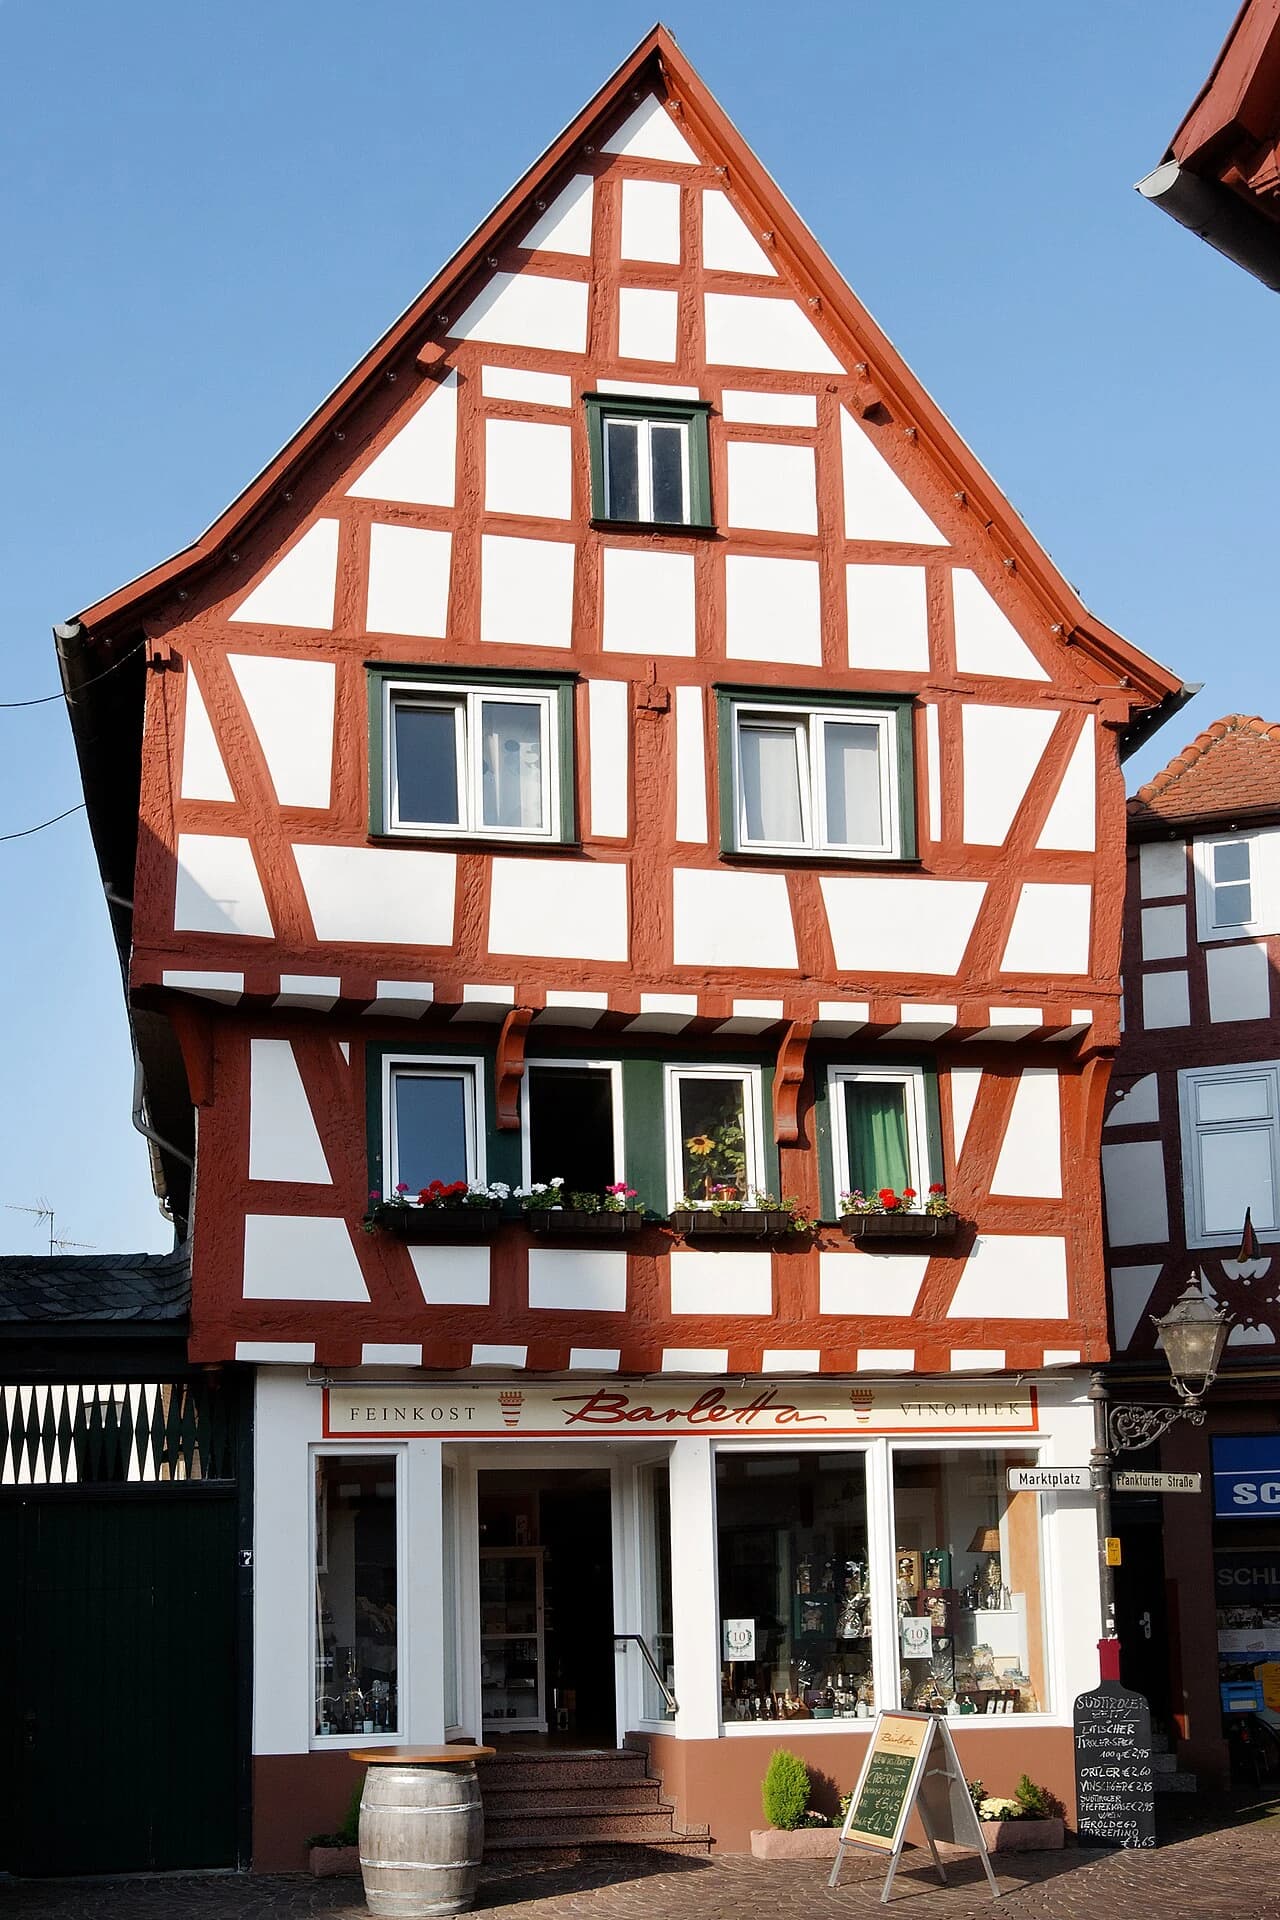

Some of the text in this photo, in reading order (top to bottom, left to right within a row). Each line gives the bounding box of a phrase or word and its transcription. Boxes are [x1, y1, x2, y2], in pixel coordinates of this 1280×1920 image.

[552, 1387, 827, 1425] Barletta
[901, 1402, 1020, 1417] VINOTHEK
[350, 1407, 476, 1421] FEINKOST
[1019, 1473, 1081, 1487] Marktplatz
[1117, 1473, 1194, 1488] Frankfurter Straße
[243, 1551, 252, 1565] 7
[733, 1631, 746, 1642] 10
[911, 1629, 923, 1639] 10
[1080, 1766, 1120, 1778] ORTLER
